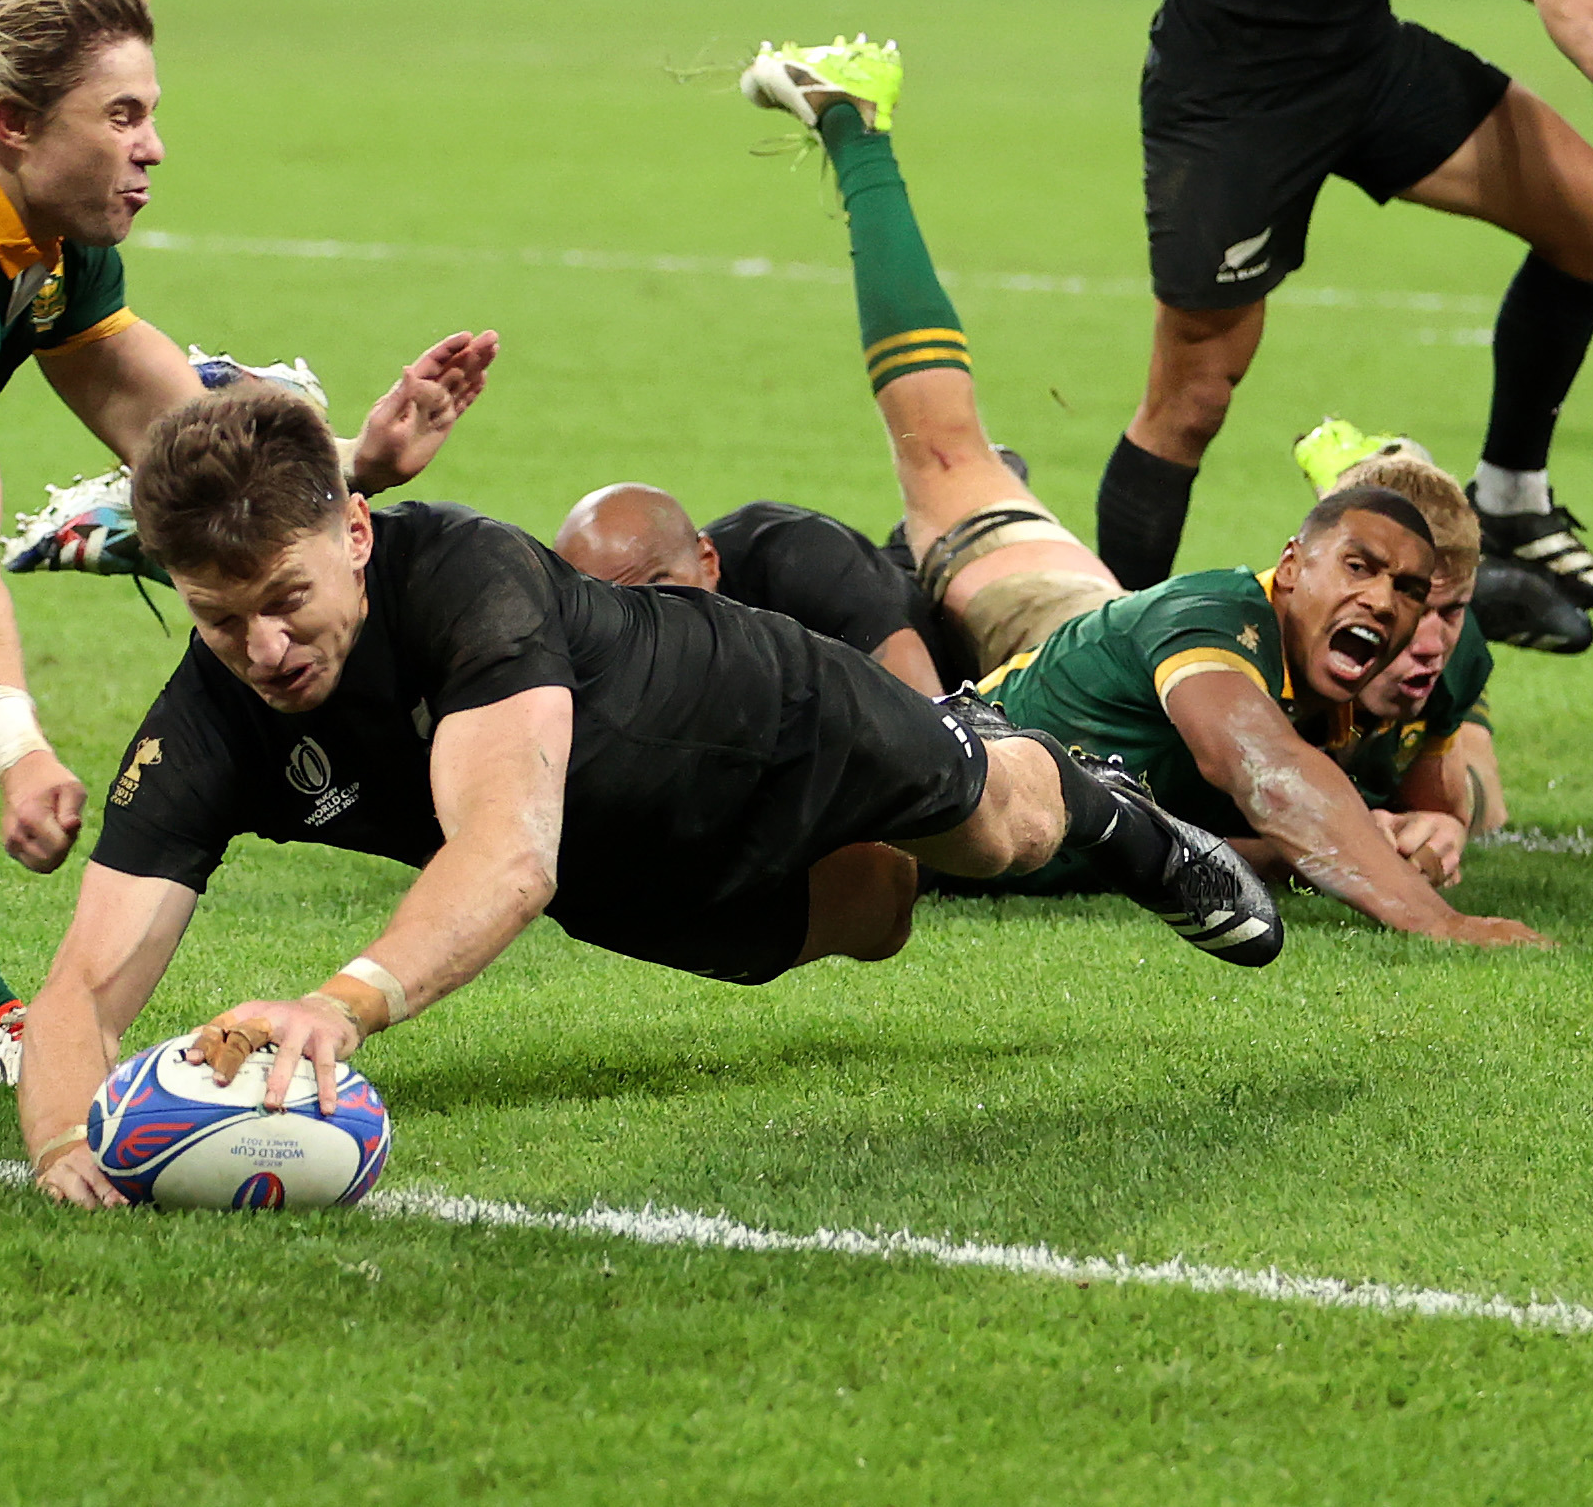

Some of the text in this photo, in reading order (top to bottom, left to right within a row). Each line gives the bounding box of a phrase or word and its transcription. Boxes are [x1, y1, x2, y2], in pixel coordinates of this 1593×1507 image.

[304, 782, 360, 825] WORLD CUP
[315, 787, 338, 806] RUGBY
[315, 806, 342, 827] FRANCE
[230, 1145, 305, 1159] WORLD CUP
[267, 1140, 299, 1148] FRANCE
